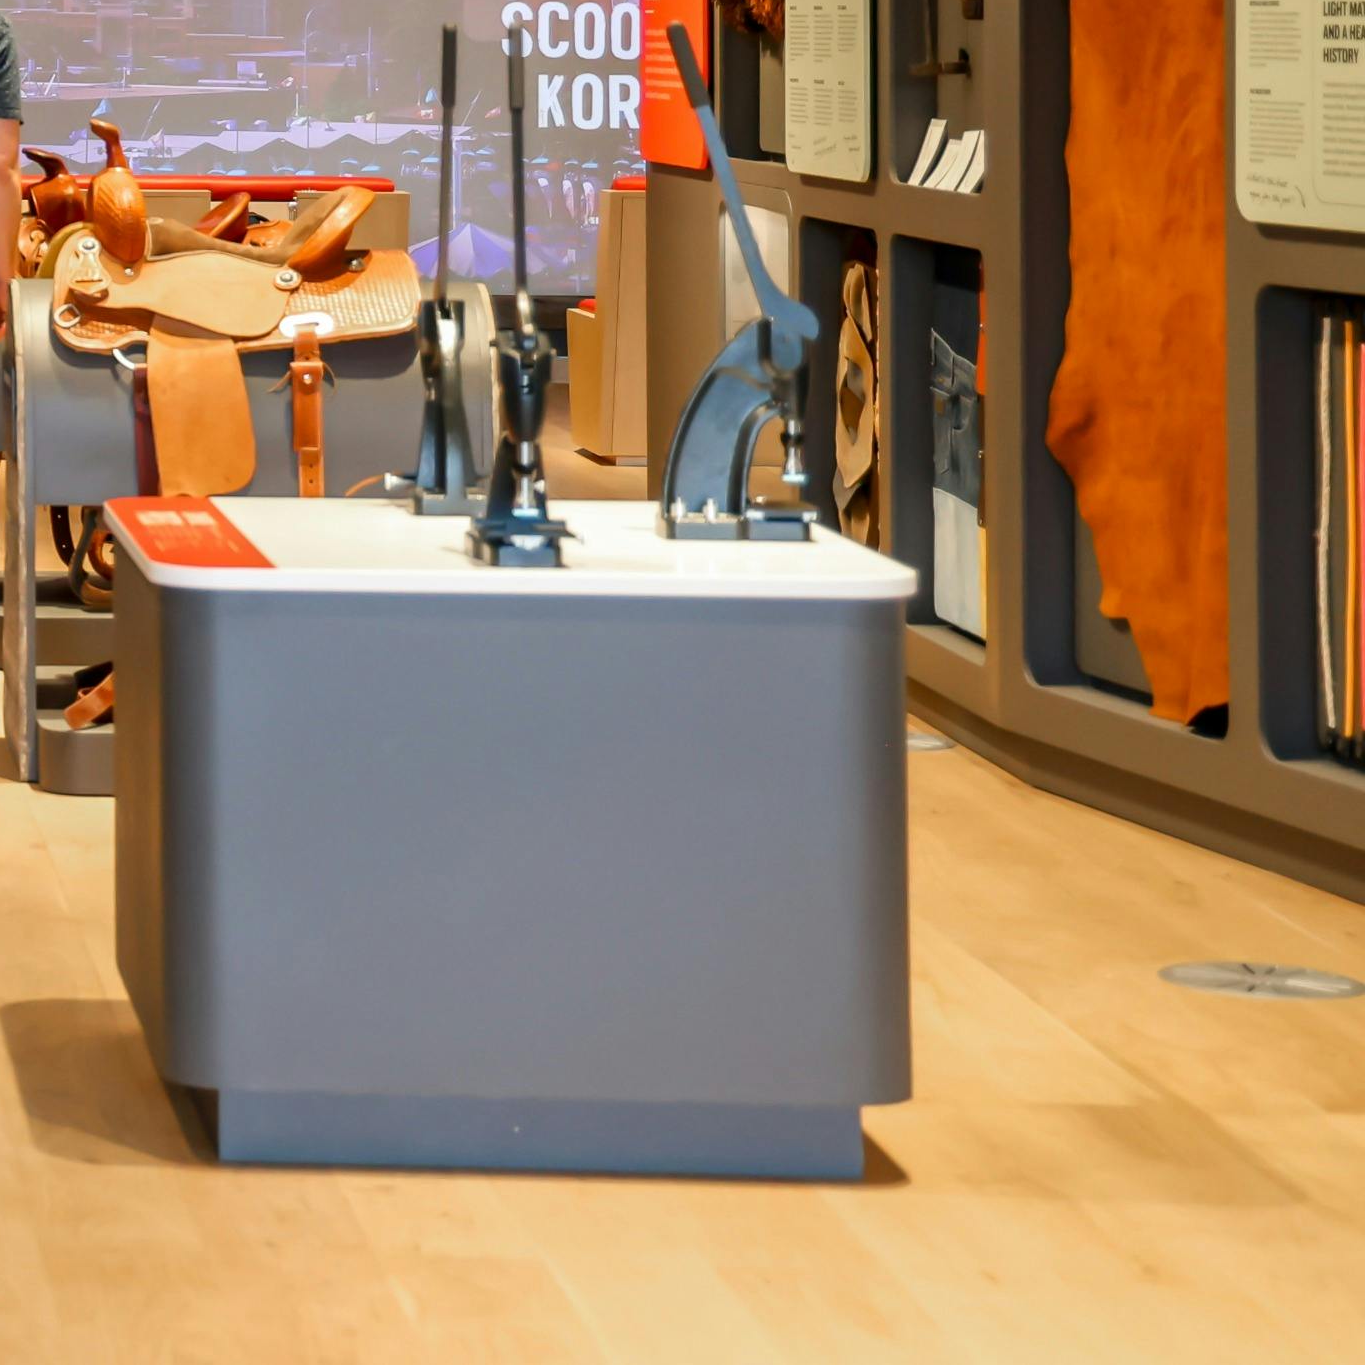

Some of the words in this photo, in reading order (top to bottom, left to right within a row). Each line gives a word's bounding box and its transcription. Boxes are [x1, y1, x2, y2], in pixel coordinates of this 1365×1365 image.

[1322, 0, 1347, 17] LIGHT
[1323, 25, 1340, 40] AND
[1342, 25, 1348, 40] A
[1323, 47, 1359, 64] HISTORY
[538, 73, 640, 130] KOR
